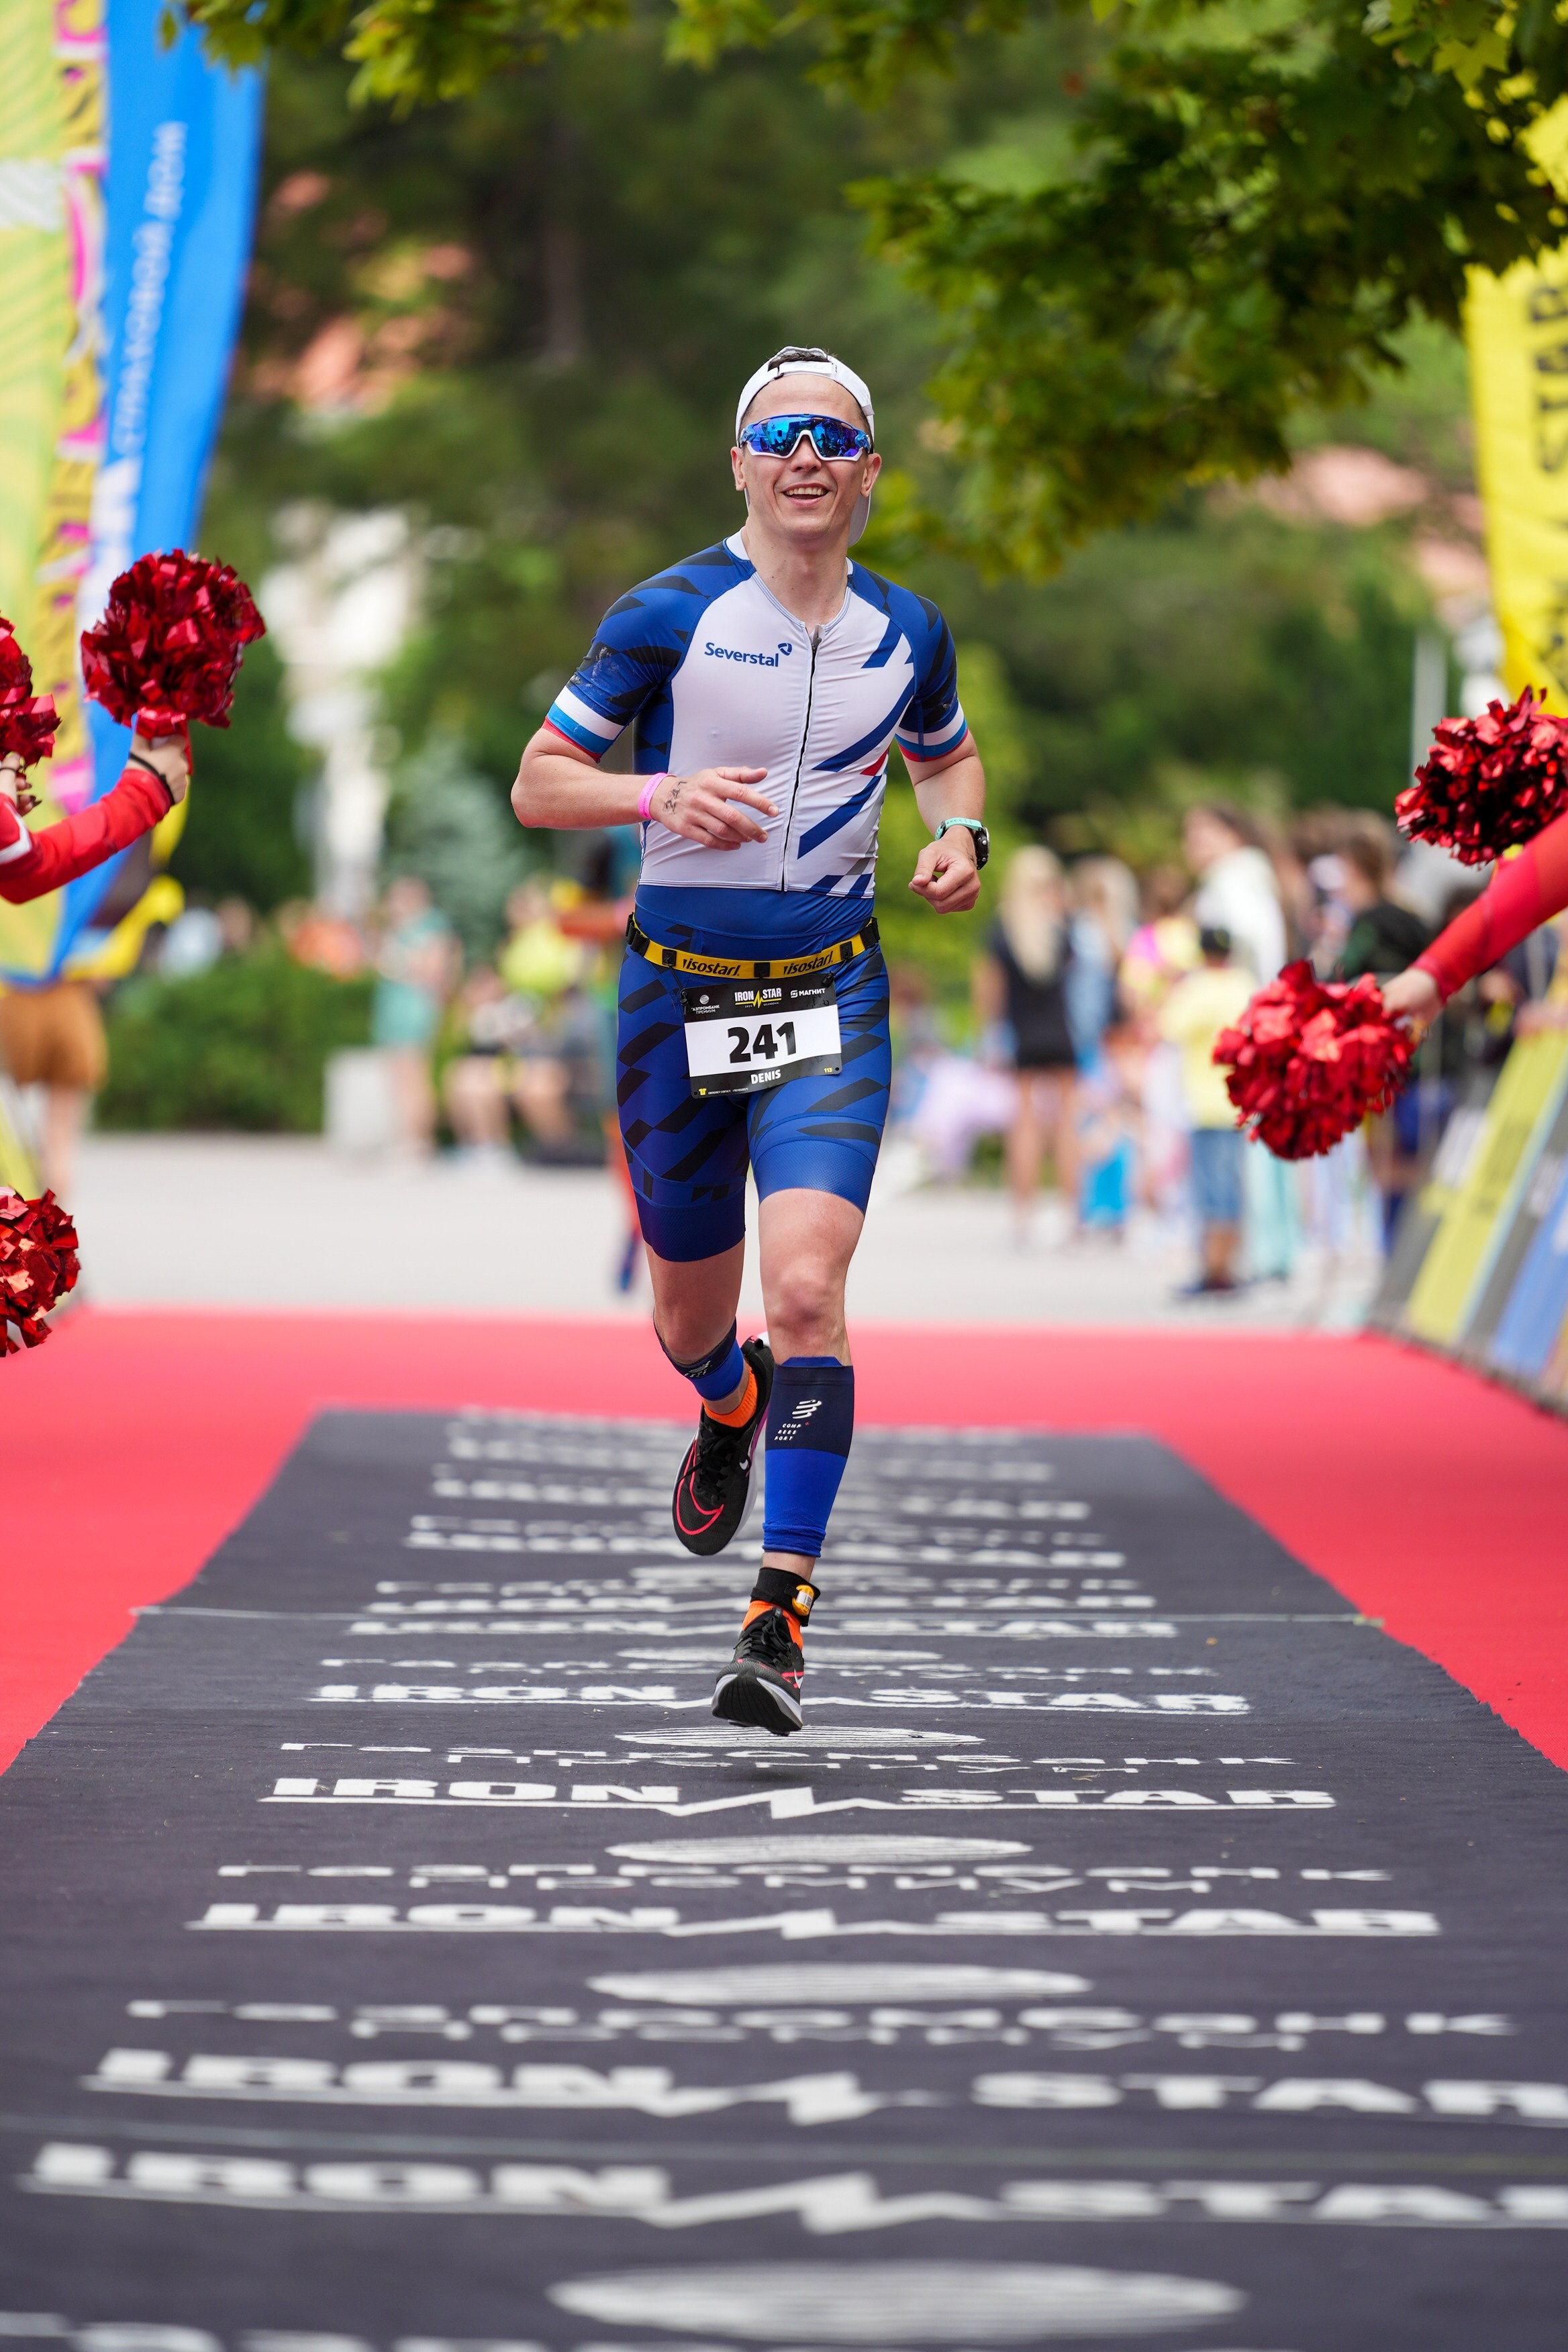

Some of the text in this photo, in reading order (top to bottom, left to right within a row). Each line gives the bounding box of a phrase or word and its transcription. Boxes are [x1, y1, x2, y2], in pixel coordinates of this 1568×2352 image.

[704, 642, 779, 667] Severstal
[734, 987, 782, 1001] IRON STAR
[799, 988, 826, 996] МАГНИТ
[727, 1021, 797, 1064] 241
[750, 1069, 781, 1085] DENIS
[319, 1684, 1251, 1712] IRON STAR
[281, 1742, 1300, 1765] Газпромбанк
[447, 1754, 1139, 1774] Премиум
[273, 1778, 1336, 1805] IRON STAR
[203, 1902, 1441, 1932] IRON STAR
[99, 2047, 673, 2104] IRON
[34, 2143, 669, 2207] IRON
